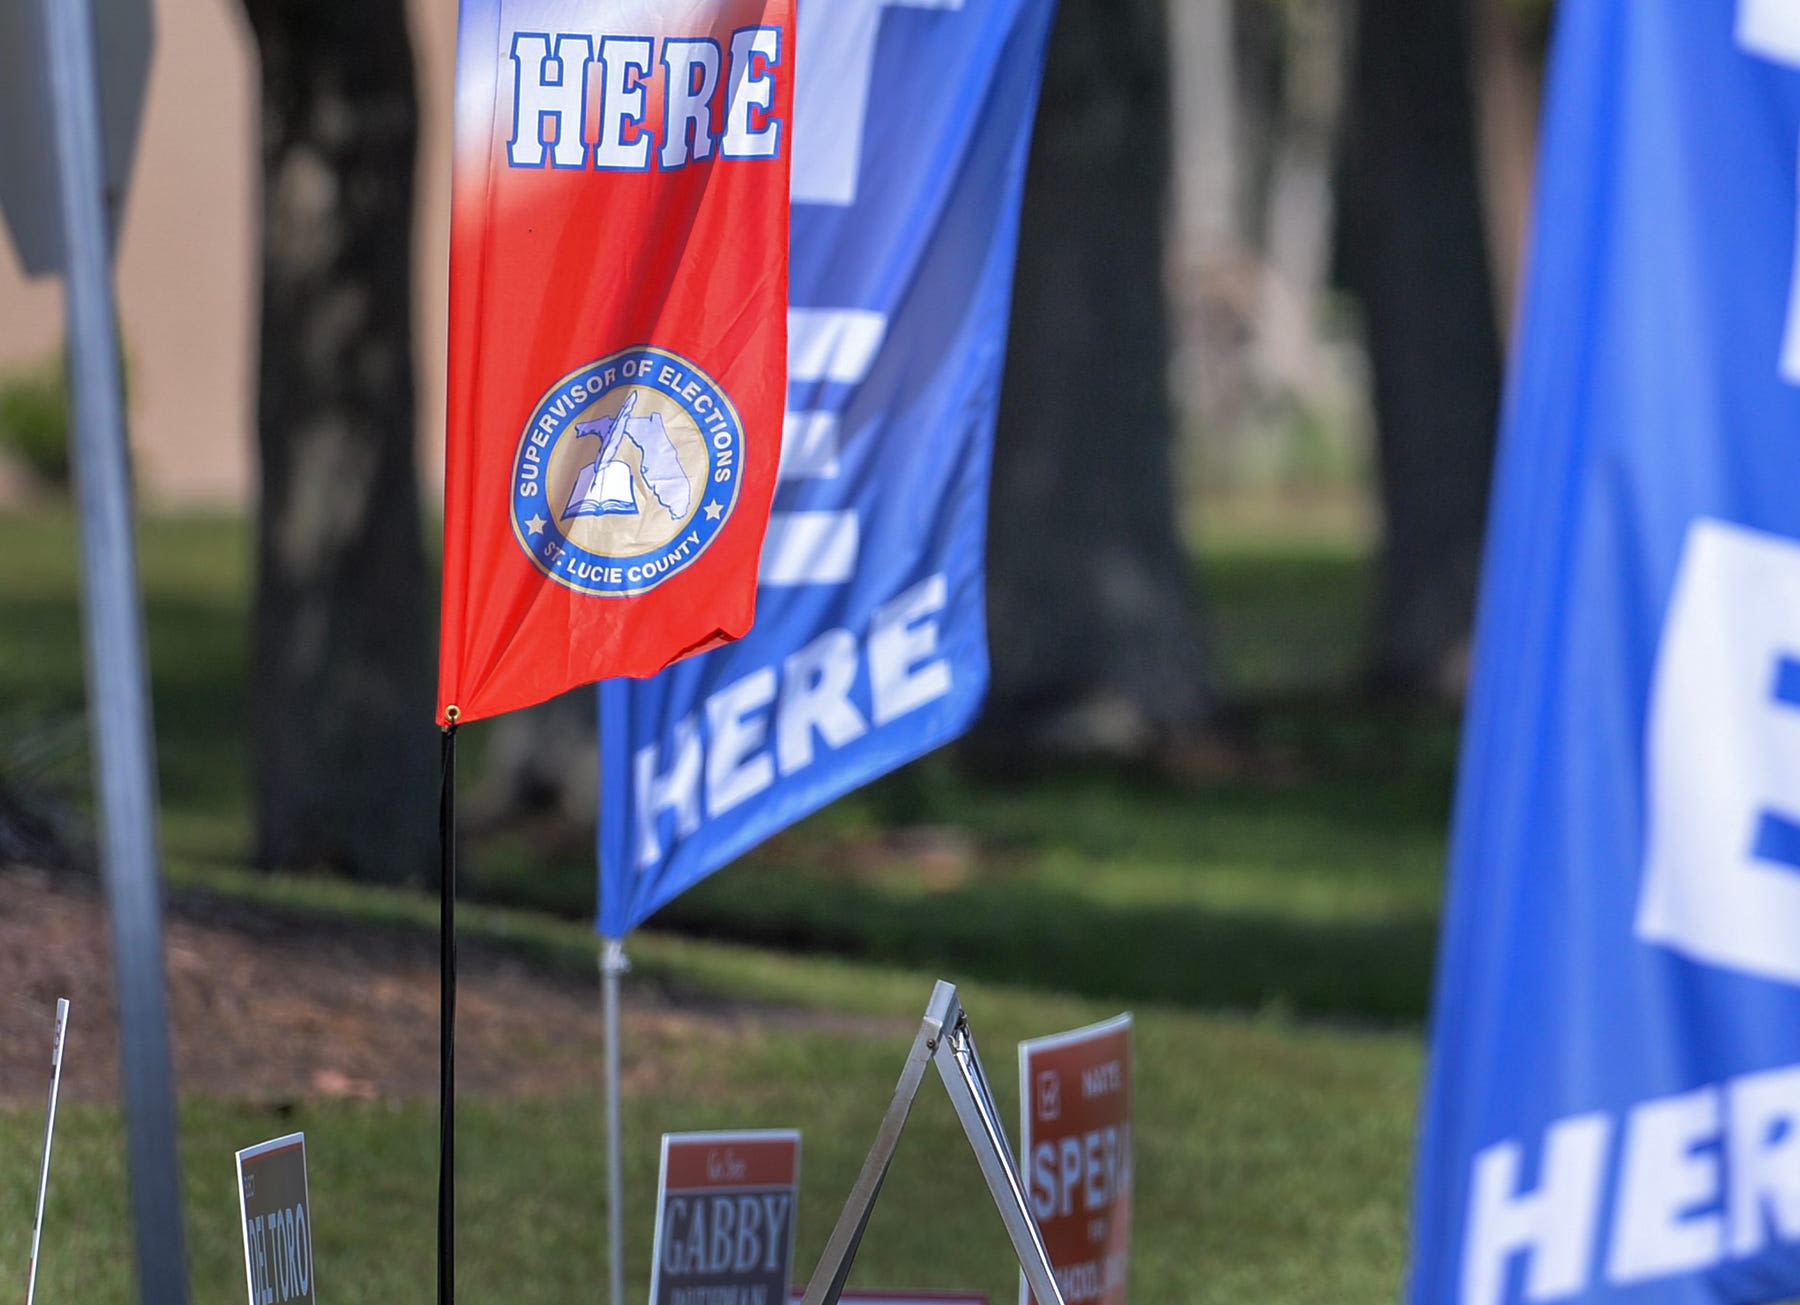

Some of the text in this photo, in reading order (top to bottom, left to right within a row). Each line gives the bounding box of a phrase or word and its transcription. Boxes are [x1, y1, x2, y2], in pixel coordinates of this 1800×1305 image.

[506, 25, 783, 172] HERE
[520, 359, 733, 497] SUPERVISOR OF ELECTIONS
[543, 530, 701, 583] ST. LUCIE COUNTY
[632, 572, 954, 872] HERE
[661, 1195, 790, 1275] GABBY
